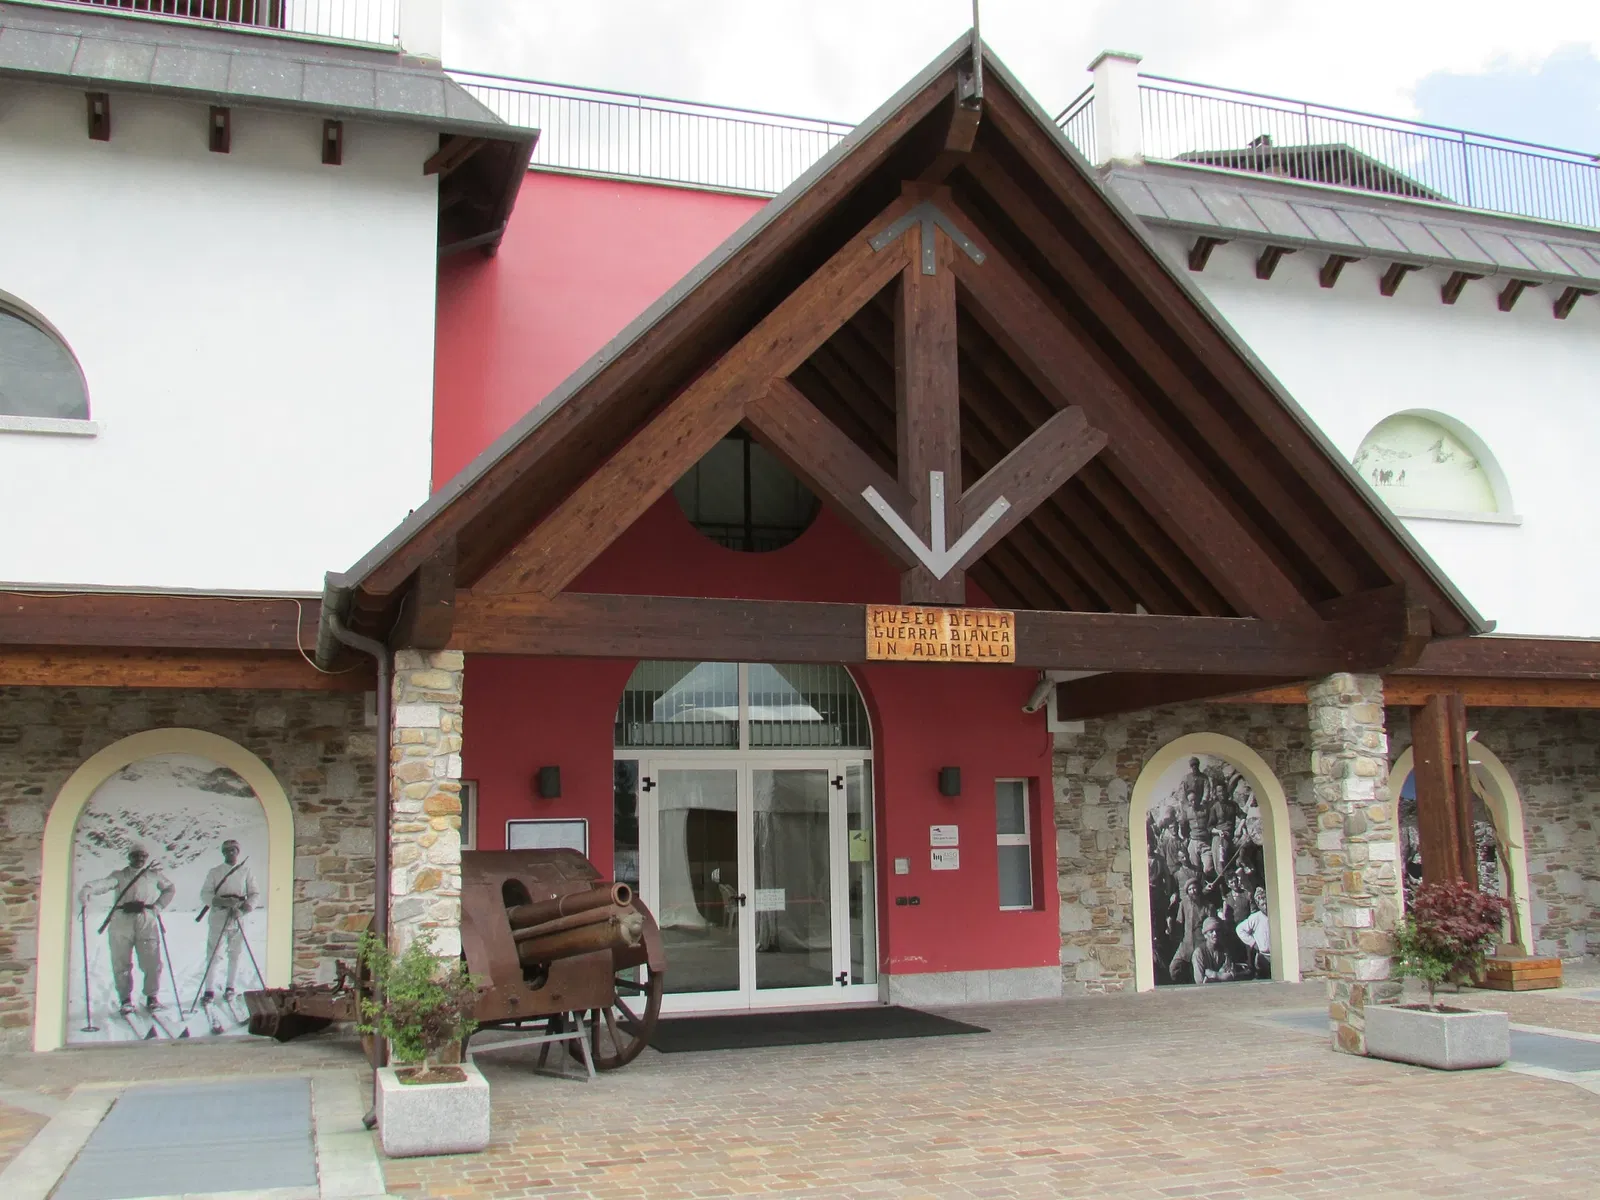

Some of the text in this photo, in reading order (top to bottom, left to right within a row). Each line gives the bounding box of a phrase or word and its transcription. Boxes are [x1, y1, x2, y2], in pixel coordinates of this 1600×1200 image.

[873, 610, 1010, 629] MUSEO DELLA
[874, 625, 1010, 642] GUERRA BIANCA
[877, 641, 1010, 657] IN ADAMELLO
